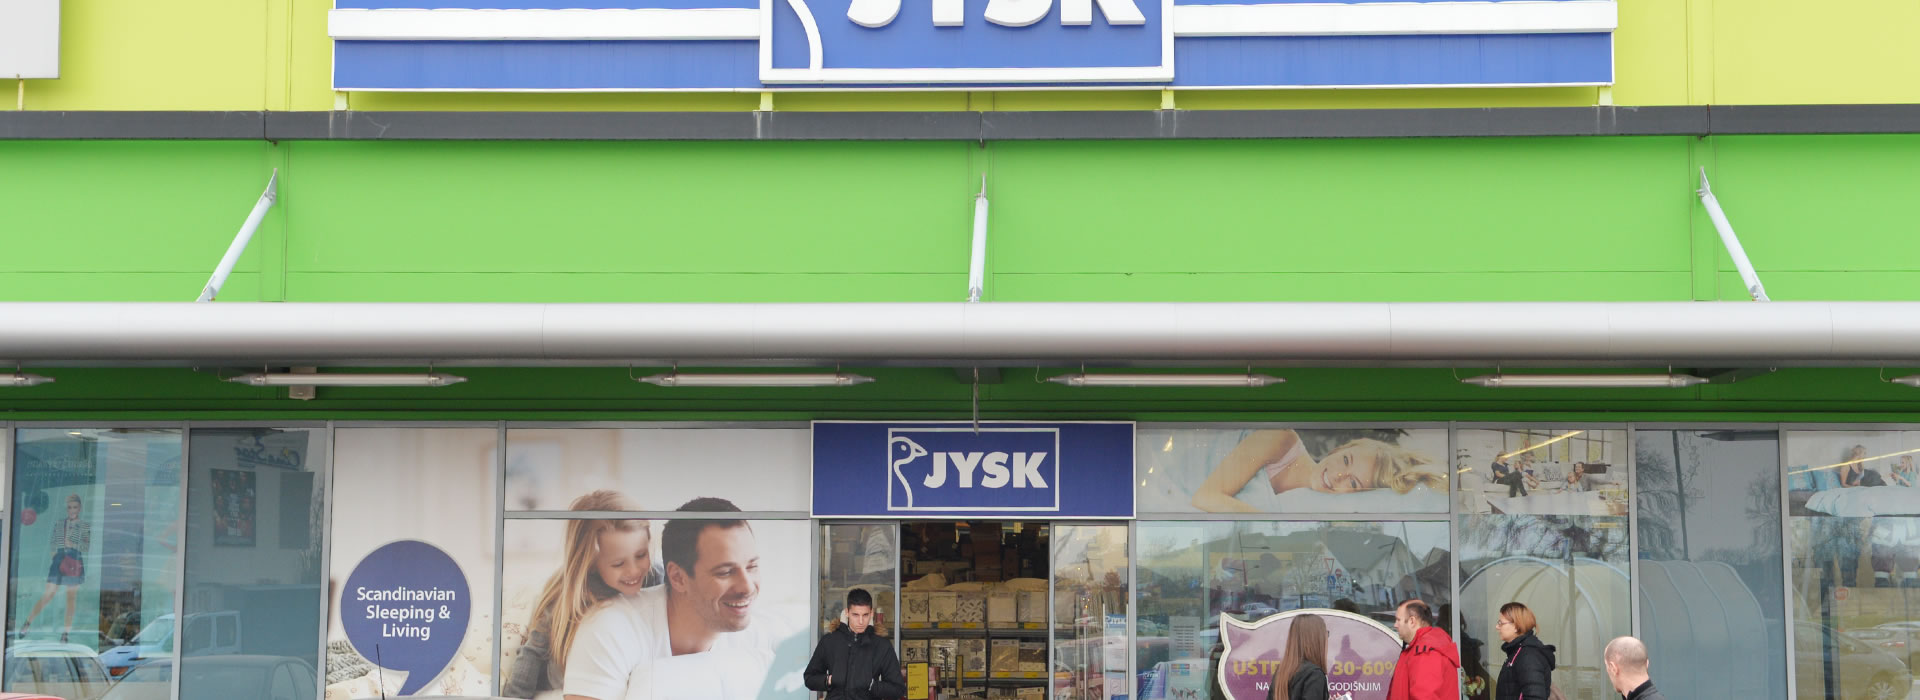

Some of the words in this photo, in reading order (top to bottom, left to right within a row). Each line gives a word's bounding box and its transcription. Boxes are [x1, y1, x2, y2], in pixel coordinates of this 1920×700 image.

[923, 451, 1049, 489] JYSK
[356, 586, 456, 601] Scandinavian
[365, 604, 435, 623] Sleeping
[438, 605, 451, 620] &
[382, 623, 431, 641] Living
